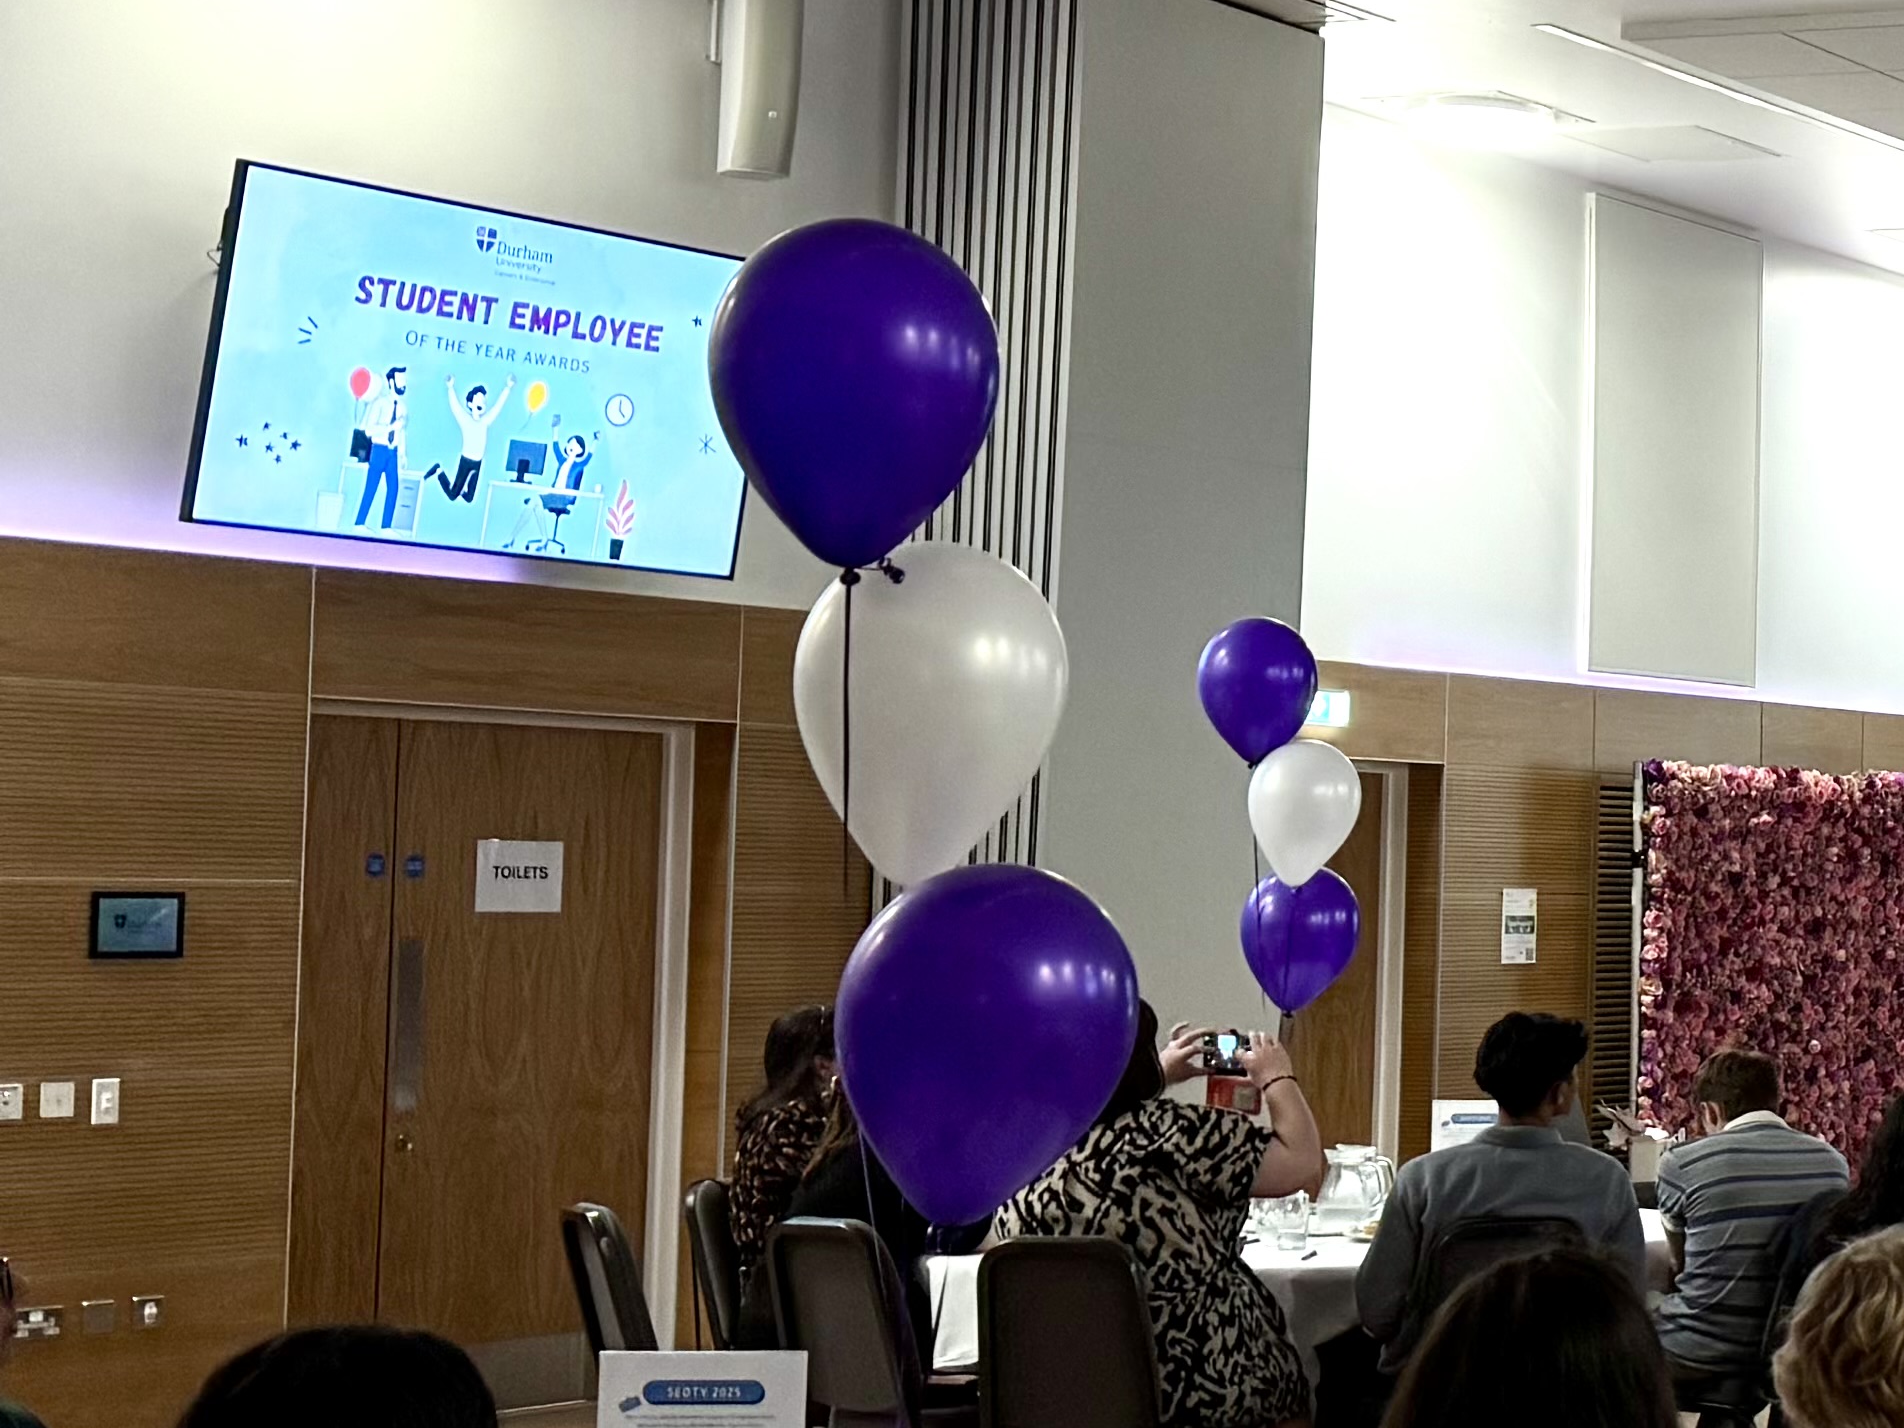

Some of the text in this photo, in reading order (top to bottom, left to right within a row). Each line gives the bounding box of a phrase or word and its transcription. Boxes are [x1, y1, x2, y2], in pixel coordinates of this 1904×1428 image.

[497, 241, 553, 264] Durham
[355, 275, 664, 352] STUDENT EMPLOYEE
[405, 330, 591, 374] OF THE YEAR AWARDS
[492, 865, 549, 880] TOILETS
[667, 1386, 742, 1399] SEOTY 2025
